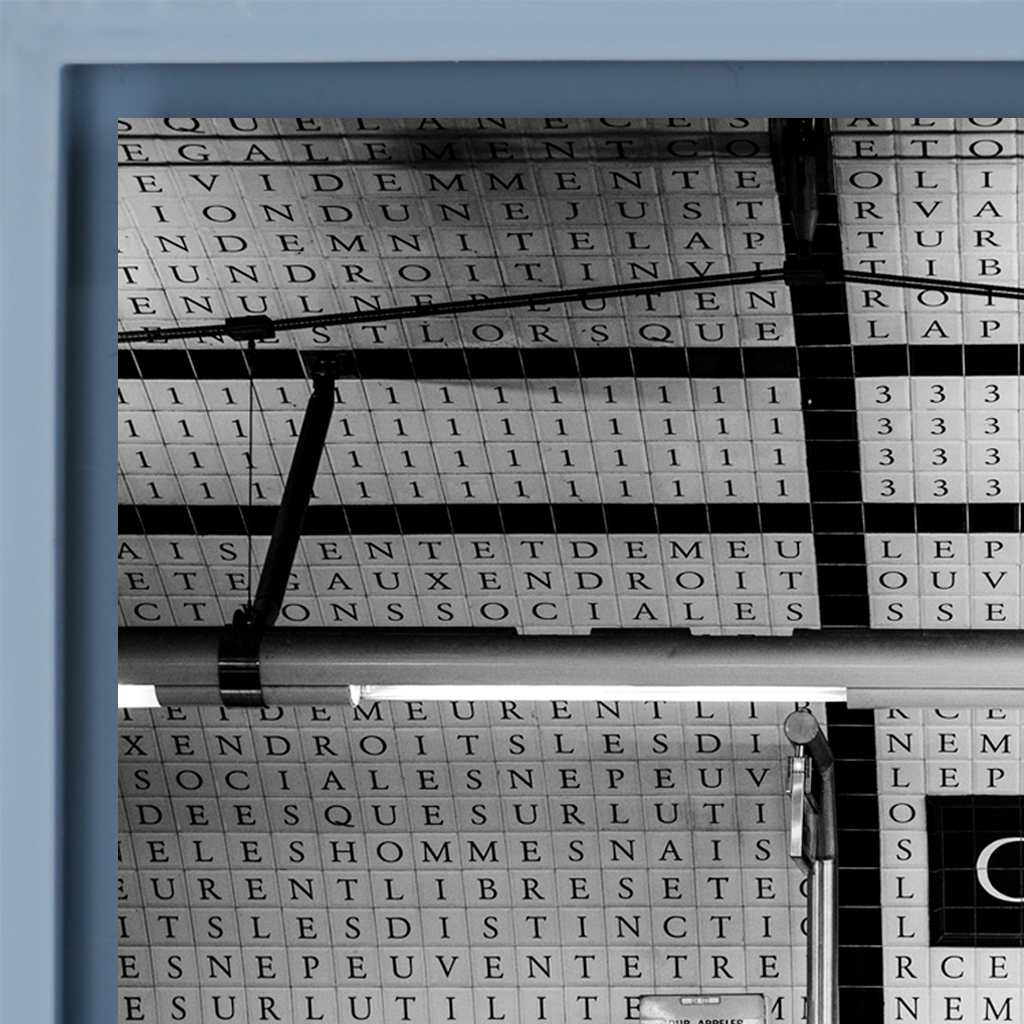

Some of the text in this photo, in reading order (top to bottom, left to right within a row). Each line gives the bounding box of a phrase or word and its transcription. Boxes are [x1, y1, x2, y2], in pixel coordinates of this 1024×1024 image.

[118, 231, 765, 253] NDEMNITELAP
[118, 540, 803, 561] AISENTETDEMEU
[133, 601, 804, 622] CTONSSOCIALES
[118, 838, 772, 863] ELESHOMMESNAIS
